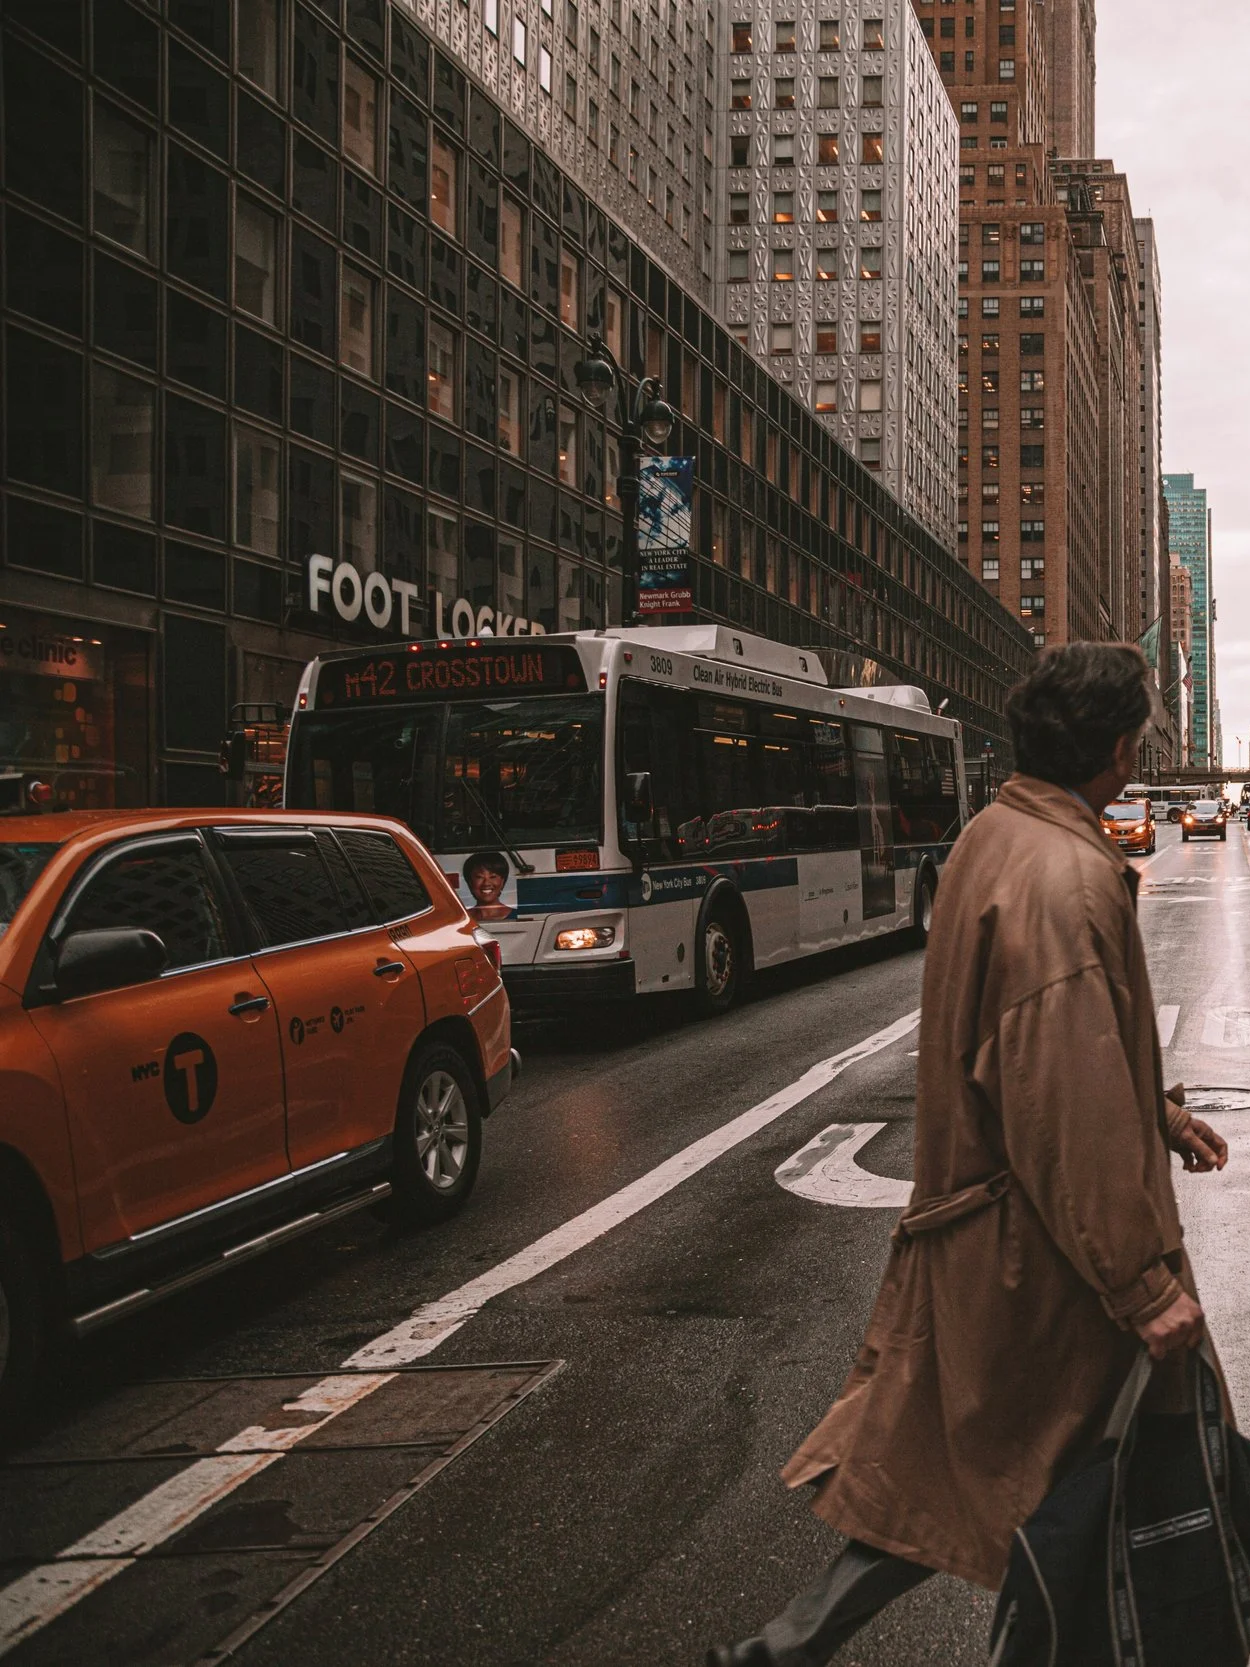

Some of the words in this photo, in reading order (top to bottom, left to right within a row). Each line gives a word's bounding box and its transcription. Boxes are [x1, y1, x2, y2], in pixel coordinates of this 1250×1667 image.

[308, 553, 419, 636] FOOT
[640, 592, 670, 600] Newmark
[670, 591, 691, 599] Grubb
[640, 600, 661, 609] Knight
[18, 634, 77, 666] clinic
[344, 661, 397, 697] M42
[406, 653, 544, 692] CROSSTOWN
[650, 655, 673, 676] 3809
[693, 665, 713, 684] Clean
[714, 670, 724, 686] Air
[726, 672, 747, 691] Hybrid
[748, 675, 770, 696] Electric
[772, 682, 783, 697] Bus
[652, 881, 663, 891] New
[663, 879, 674, 889] York
[674, 877, 683, 889] City
[683, 876, 692, 887] Bus
[131, 1061, 161, 1082] NYC
[174, 1048, 205, 1113] T
